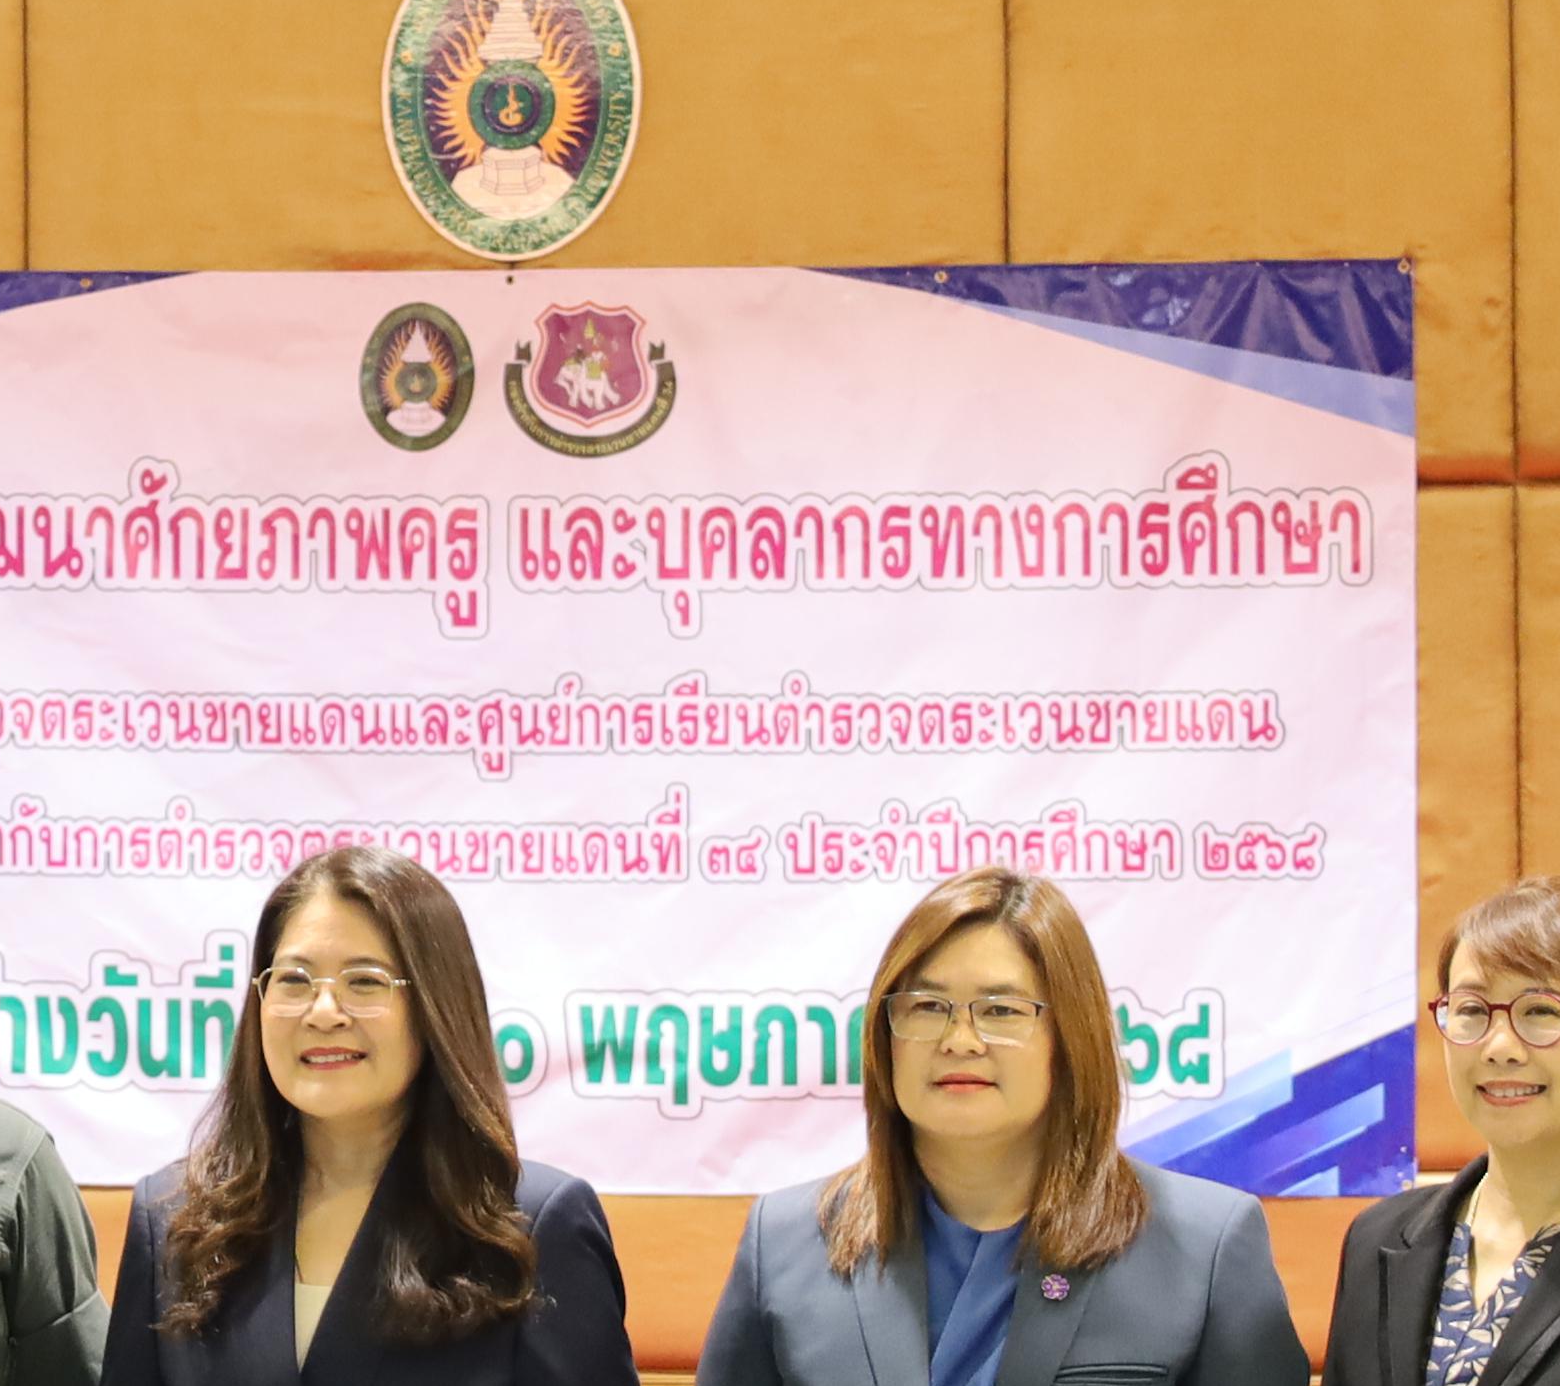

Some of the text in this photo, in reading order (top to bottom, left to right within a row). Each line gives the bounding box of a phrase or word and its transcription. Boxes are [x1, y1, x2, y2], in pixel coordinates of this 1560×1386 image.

[517, 462, 1364, 627] และบุคลากรทางการศึกษา
[1202, 830, 1318, 872] ๒๕๖๘
[579, 1004, 865, 1106] พฤษภา
[1116, 1002, 1211, 1086] ๖๘
